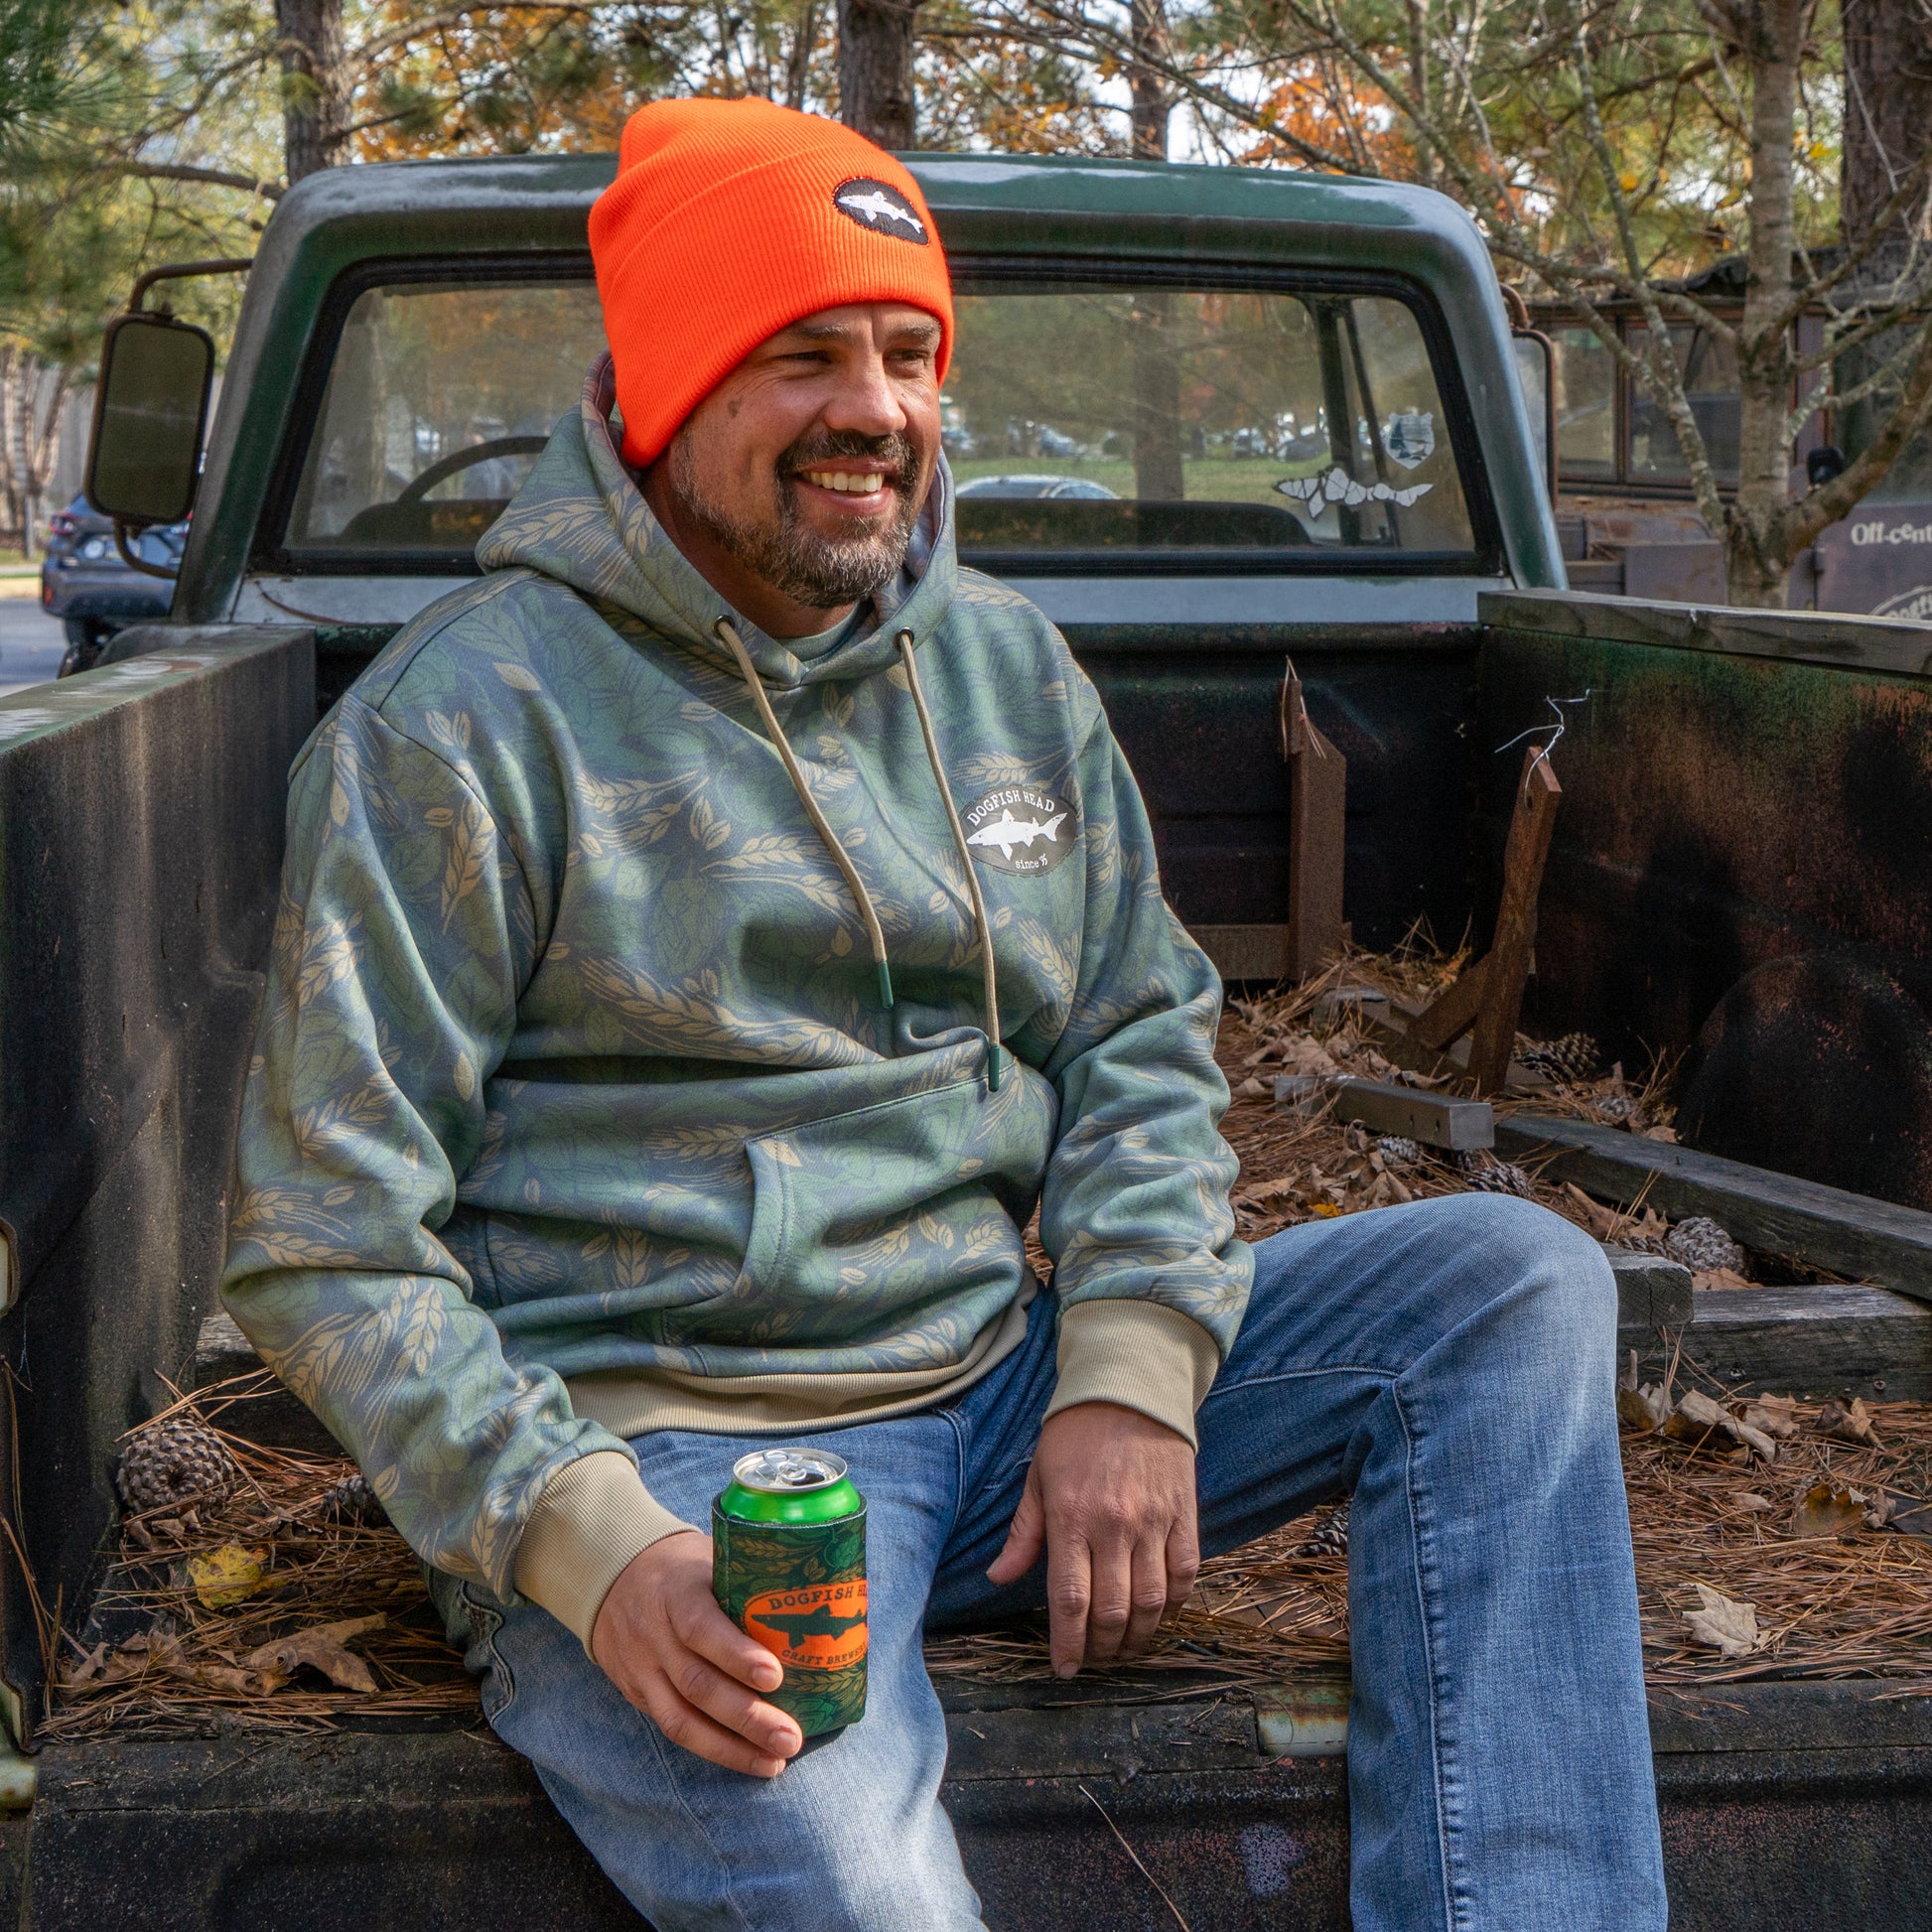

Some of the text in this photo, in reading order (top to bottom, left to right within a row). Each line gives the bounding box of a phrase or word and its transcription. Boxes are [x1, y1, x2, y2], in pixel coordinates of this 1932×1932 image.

[967, 789, 1054, 826] DOGFISH HEAD
[1015, 859, 1039, 869] since
[768, 1587, 853, 1610] DOGFISH
[781, 1649, 823, 1665] CRAFT
